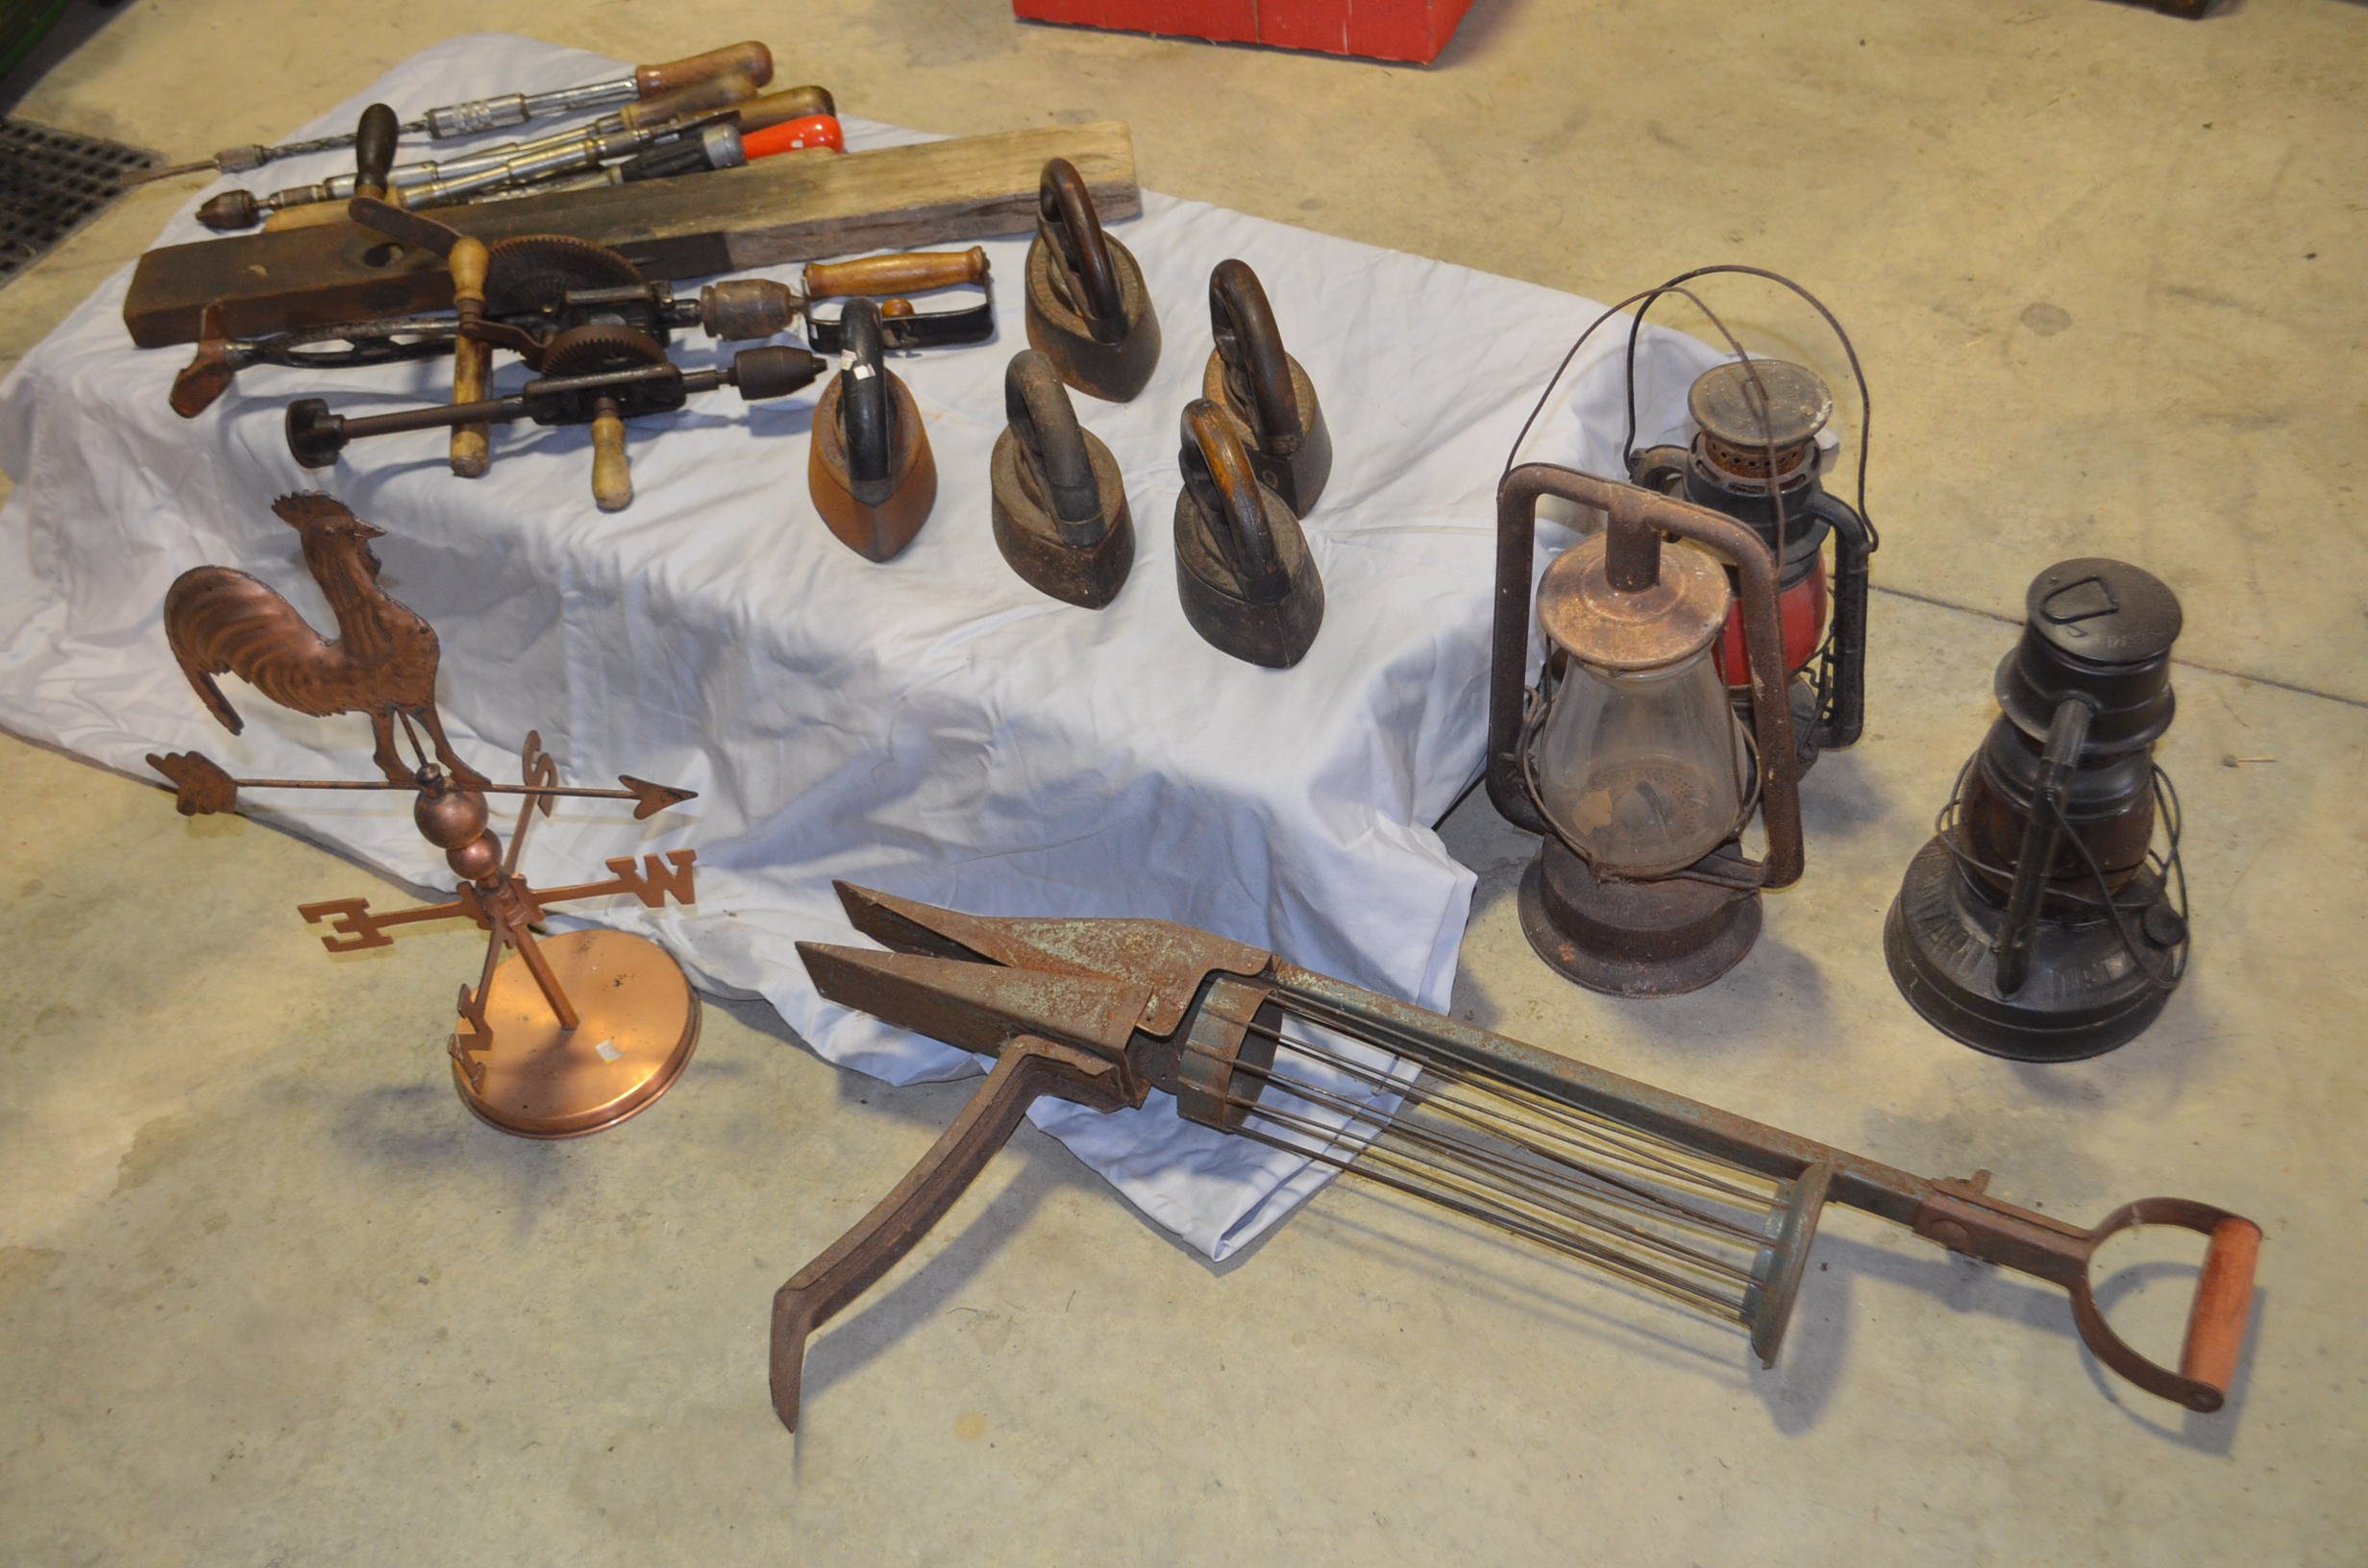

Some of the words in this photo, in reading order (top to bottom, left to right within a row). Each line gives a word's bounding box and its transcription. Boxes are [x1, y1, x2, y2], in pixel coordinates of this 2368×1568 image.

[522, 730, 559, 818] S
[605, 848, 698, 908] W
[448, 984, 494, 1094] N
